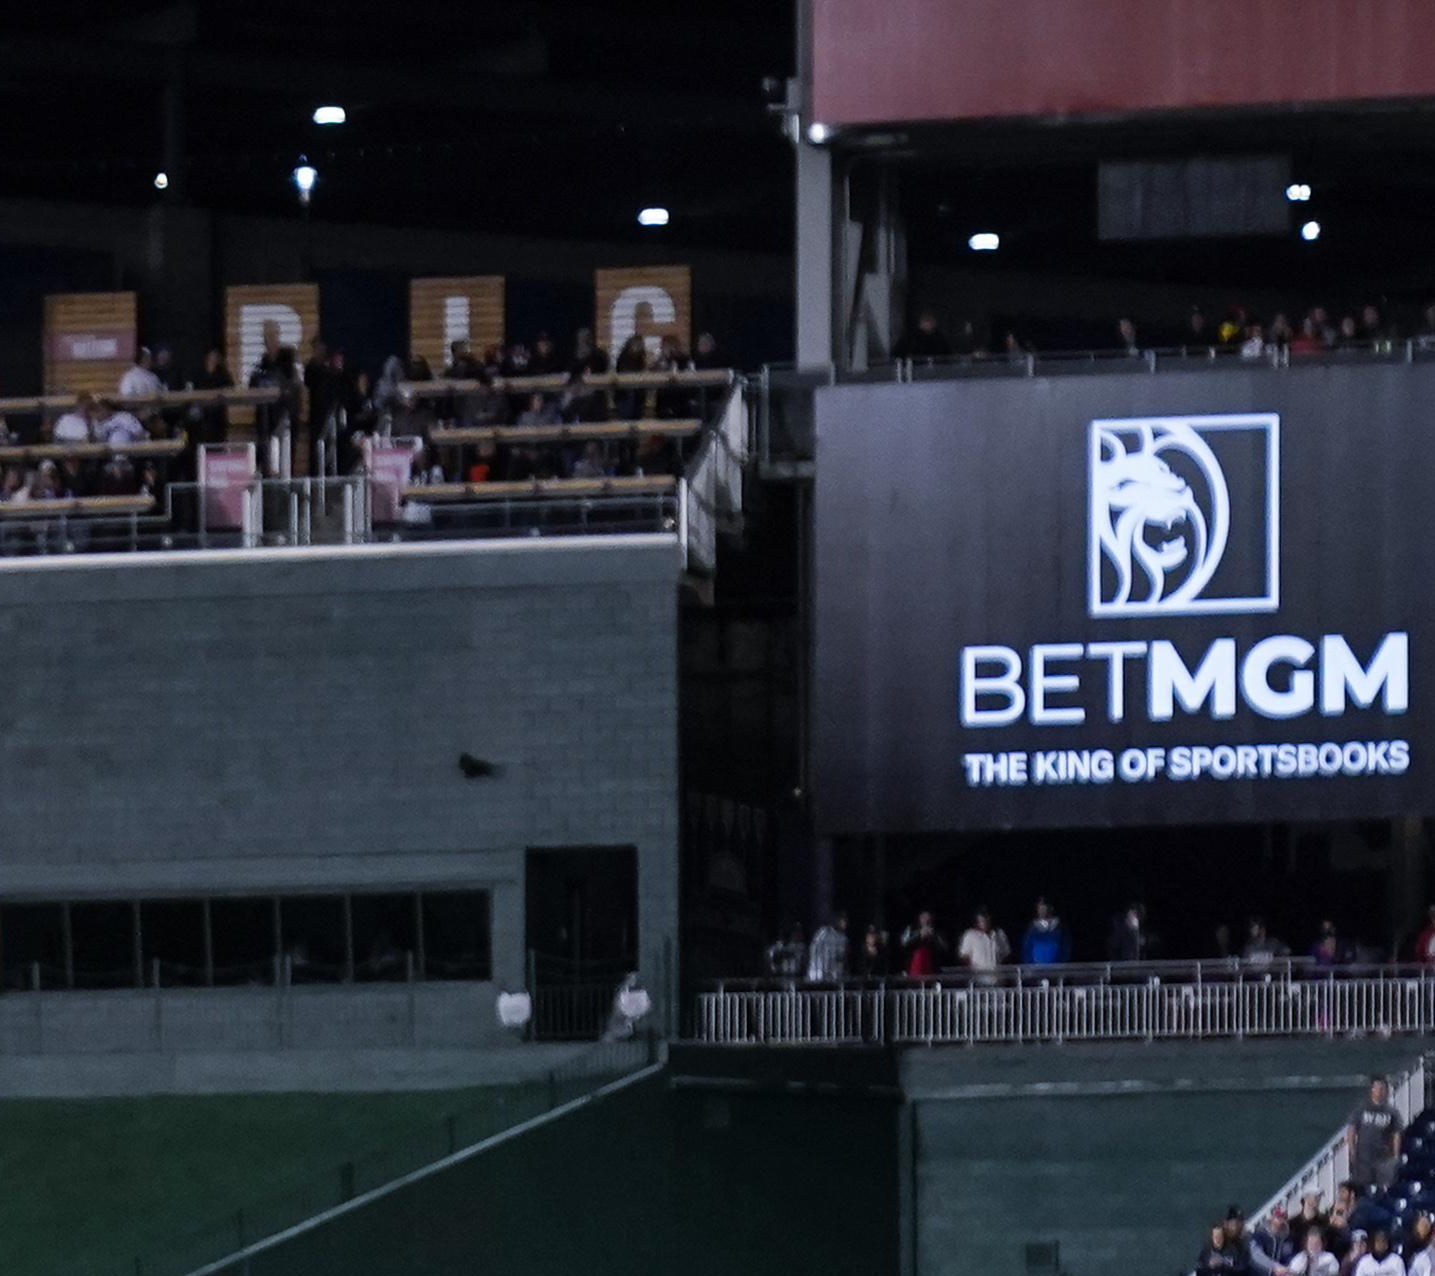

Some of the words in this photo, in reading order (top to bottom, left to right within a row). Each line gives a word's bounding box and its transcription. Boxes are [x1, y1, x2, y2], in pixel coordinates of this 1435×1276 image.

[960, 632, 1409, 728] BETMGM
[964, 752, 1027, 786] THE
[1032, 749, 1114, 784] KING
[1120, 747, 1165, 782] OF
[1167, 739, 1410, 781] SPORTSBOOKS
